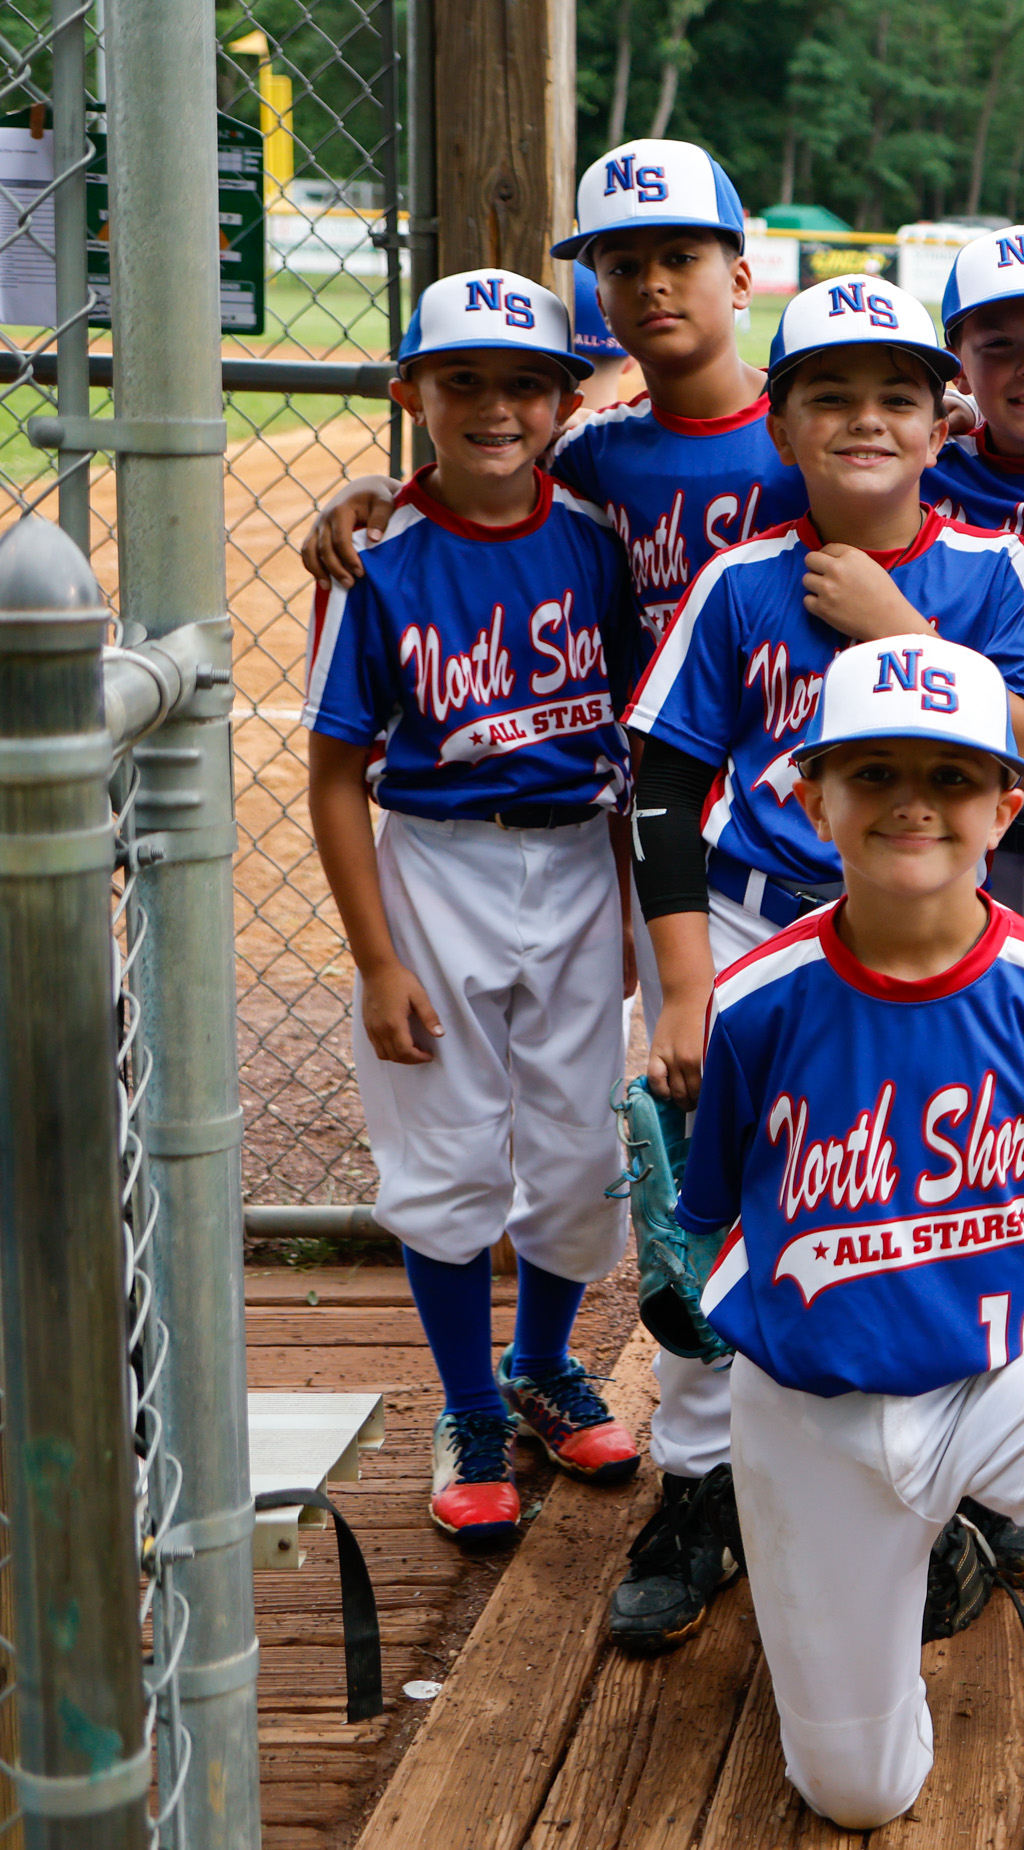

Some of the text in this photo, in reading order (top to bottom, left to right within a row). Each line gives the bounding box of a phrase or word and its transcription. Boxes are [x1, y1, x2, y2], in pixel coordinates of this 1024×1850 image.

[604, 154, 668, 202] NS
[465, 278, 536, 329] NS
[828, 281, 899, 329] NS
[400, 602, 517, 723] North
[745, 639, 824, 743] Nor
[873, 648, 960, 715] NS
[488, 718, 528, 748] ALL
[767, 1079, 899, 1224] North
[832, 1209, 1022, 1267] ALL STARS
